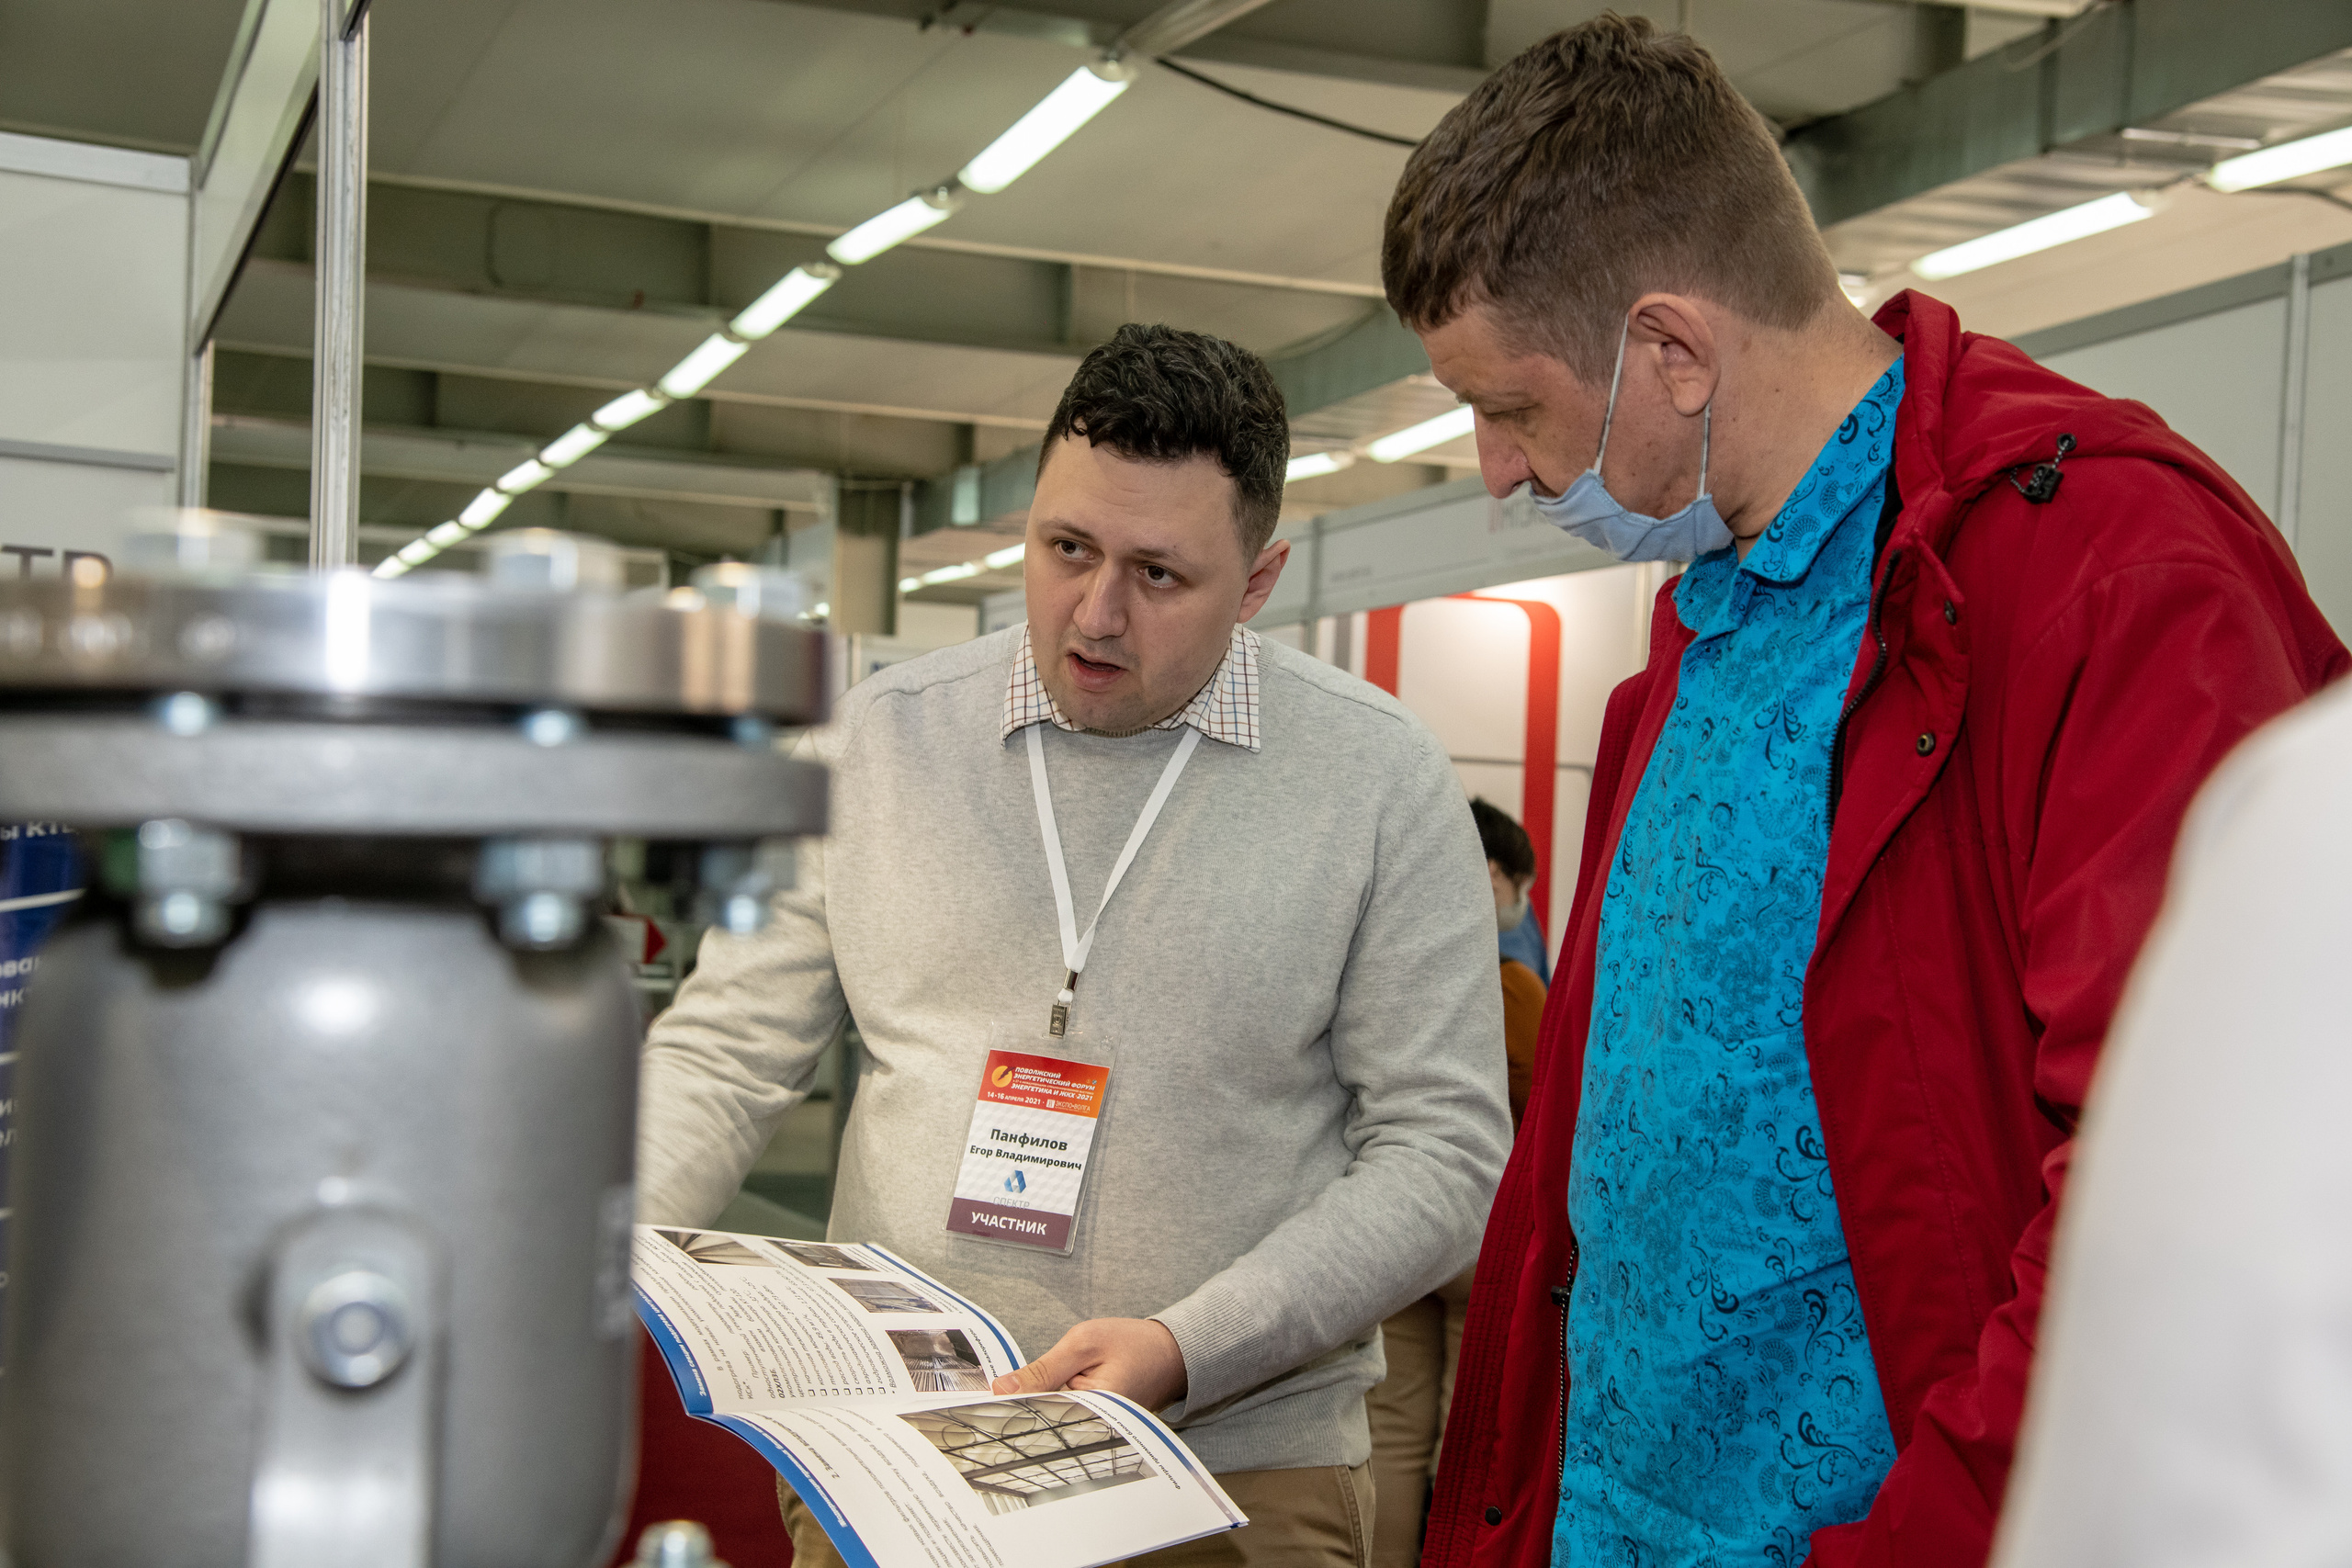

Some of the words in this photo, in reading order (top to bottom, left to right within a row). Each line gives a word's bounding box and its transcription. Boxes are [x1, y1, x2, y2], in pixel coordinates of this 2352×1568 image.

[1013, 1074, 1070, 1087] ЭНЕРГЕТИЧЕСКИЙ
[1015, 1066, 1061, 1078] ПОВОЛЖСКИЙ
[1012, 1083, 1052, 1095] ЭНЕРГЕТИКА
[1059, 1090, 1076, 1099] ЖКХ
[1024, 1097, 1041, 1105] 2021
[1055, 1100, 1091, 1111] ЭКСПО-ВОЛГА
[990, 1128, 1068, 1151] Панфилов
[970, 1145, 993, 1158] Егор
[995, 1149, 1082, 1170] Владимирович
[993, 1196, 1029, 1210] СПЕКТР
[971, 1212, 1047, 1235] УЧАСТНИК
[657, 1314, 682, 1343] подогрева
[669, 1296, 703, 1336] модернизации
[748, 1304, 780, 1344] кондиционера
[775, 1311, 808, 1352] температура
[968, 1327, 992, 1363] калориферы
[679, 1344, 695, 1367] секции
[703, 1338, 720, 1361] рамках
[718, 1348, 727, 1357] на
[741, 1348, 759, 1378] Пример:
[757, 1328, 796, 1398] укомплектованным
[834, 1323, 872, 1384] аэродинамическое
[725, 1360, 744, 1400] подогрева
[741, 1334, 775, 1399] одноступенчатой
[779, 1346, 805, 1398] центрального
[791, 1348, 812, 1384] начальная
[807, 1352, 825, 1386] конечная
[817, 1350, 836, 1385] тепловая
[832, 1360, 849, 1385] расход
[842, 1351, 860, 1385] скорость
[691, 1368, 707, 1396] Замена
[1116, 1421, 1134, 1435] блока
[869, 1444, 892, 1466] воздуха
[1132, 1436, 1161, 1464] приемного
[845, 1447, 885, 1490] положительно
[891, 1468, 913, 1492] очистку
[1159, 1464, 1182, 1490] Фильтры
[884, 1491, 910, 1523] фильтров
[912, 1494, 942, 1532] первичную
[944, 1501, 967, 1531] качество
[908, 1524, 925, 1545] новых
